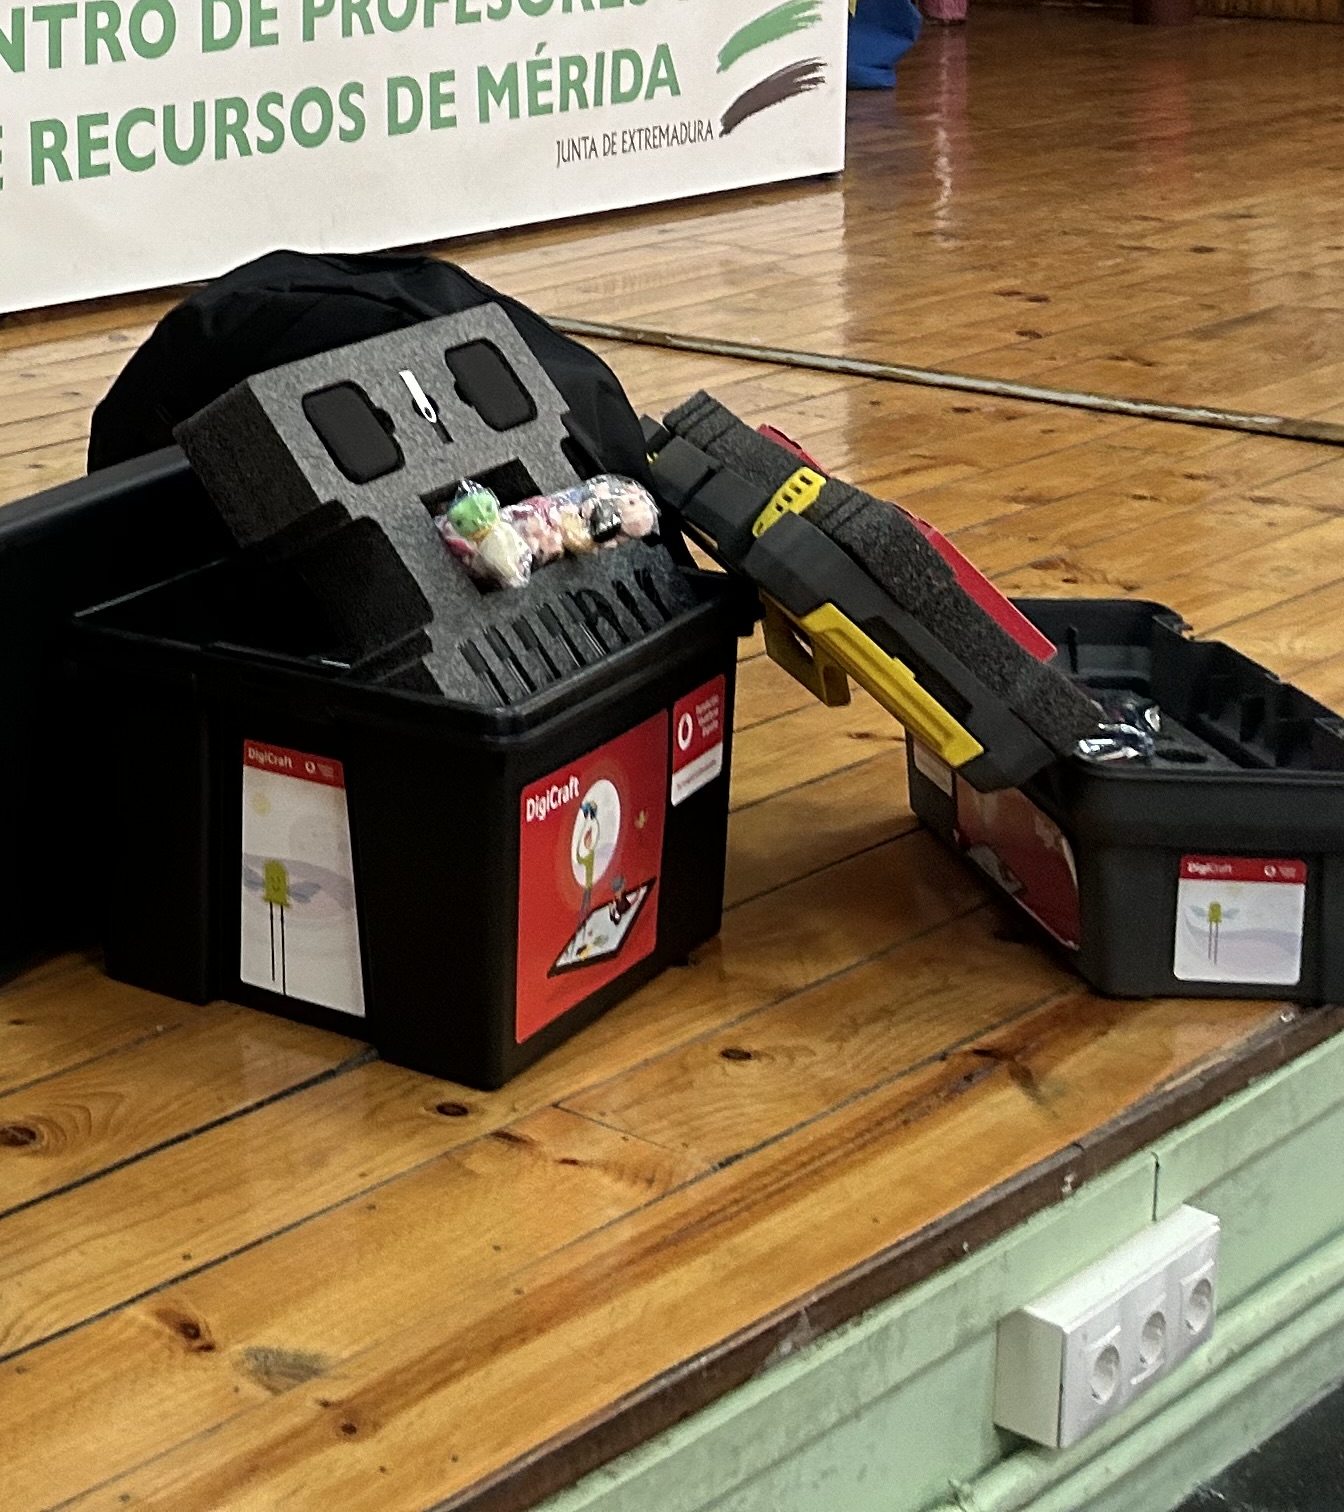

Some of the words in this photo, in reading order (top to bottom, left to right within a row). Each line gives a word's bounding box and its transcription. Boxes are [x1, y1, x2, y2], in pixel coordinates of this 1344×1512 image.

[29, 79, 367, 187] RECURSOS
[386, 68, 457, 137] DE
[477, 42, 682, 125] MÉRIDA
[556, 135, 599, 168] JUNTA
[602, 130, 618, 157] DE
[621, 119, 714, 154] EXTREMADURA
[247, 746, 293, 769] DigiCraft
[525, 774, 580, 823] DigiCraft
